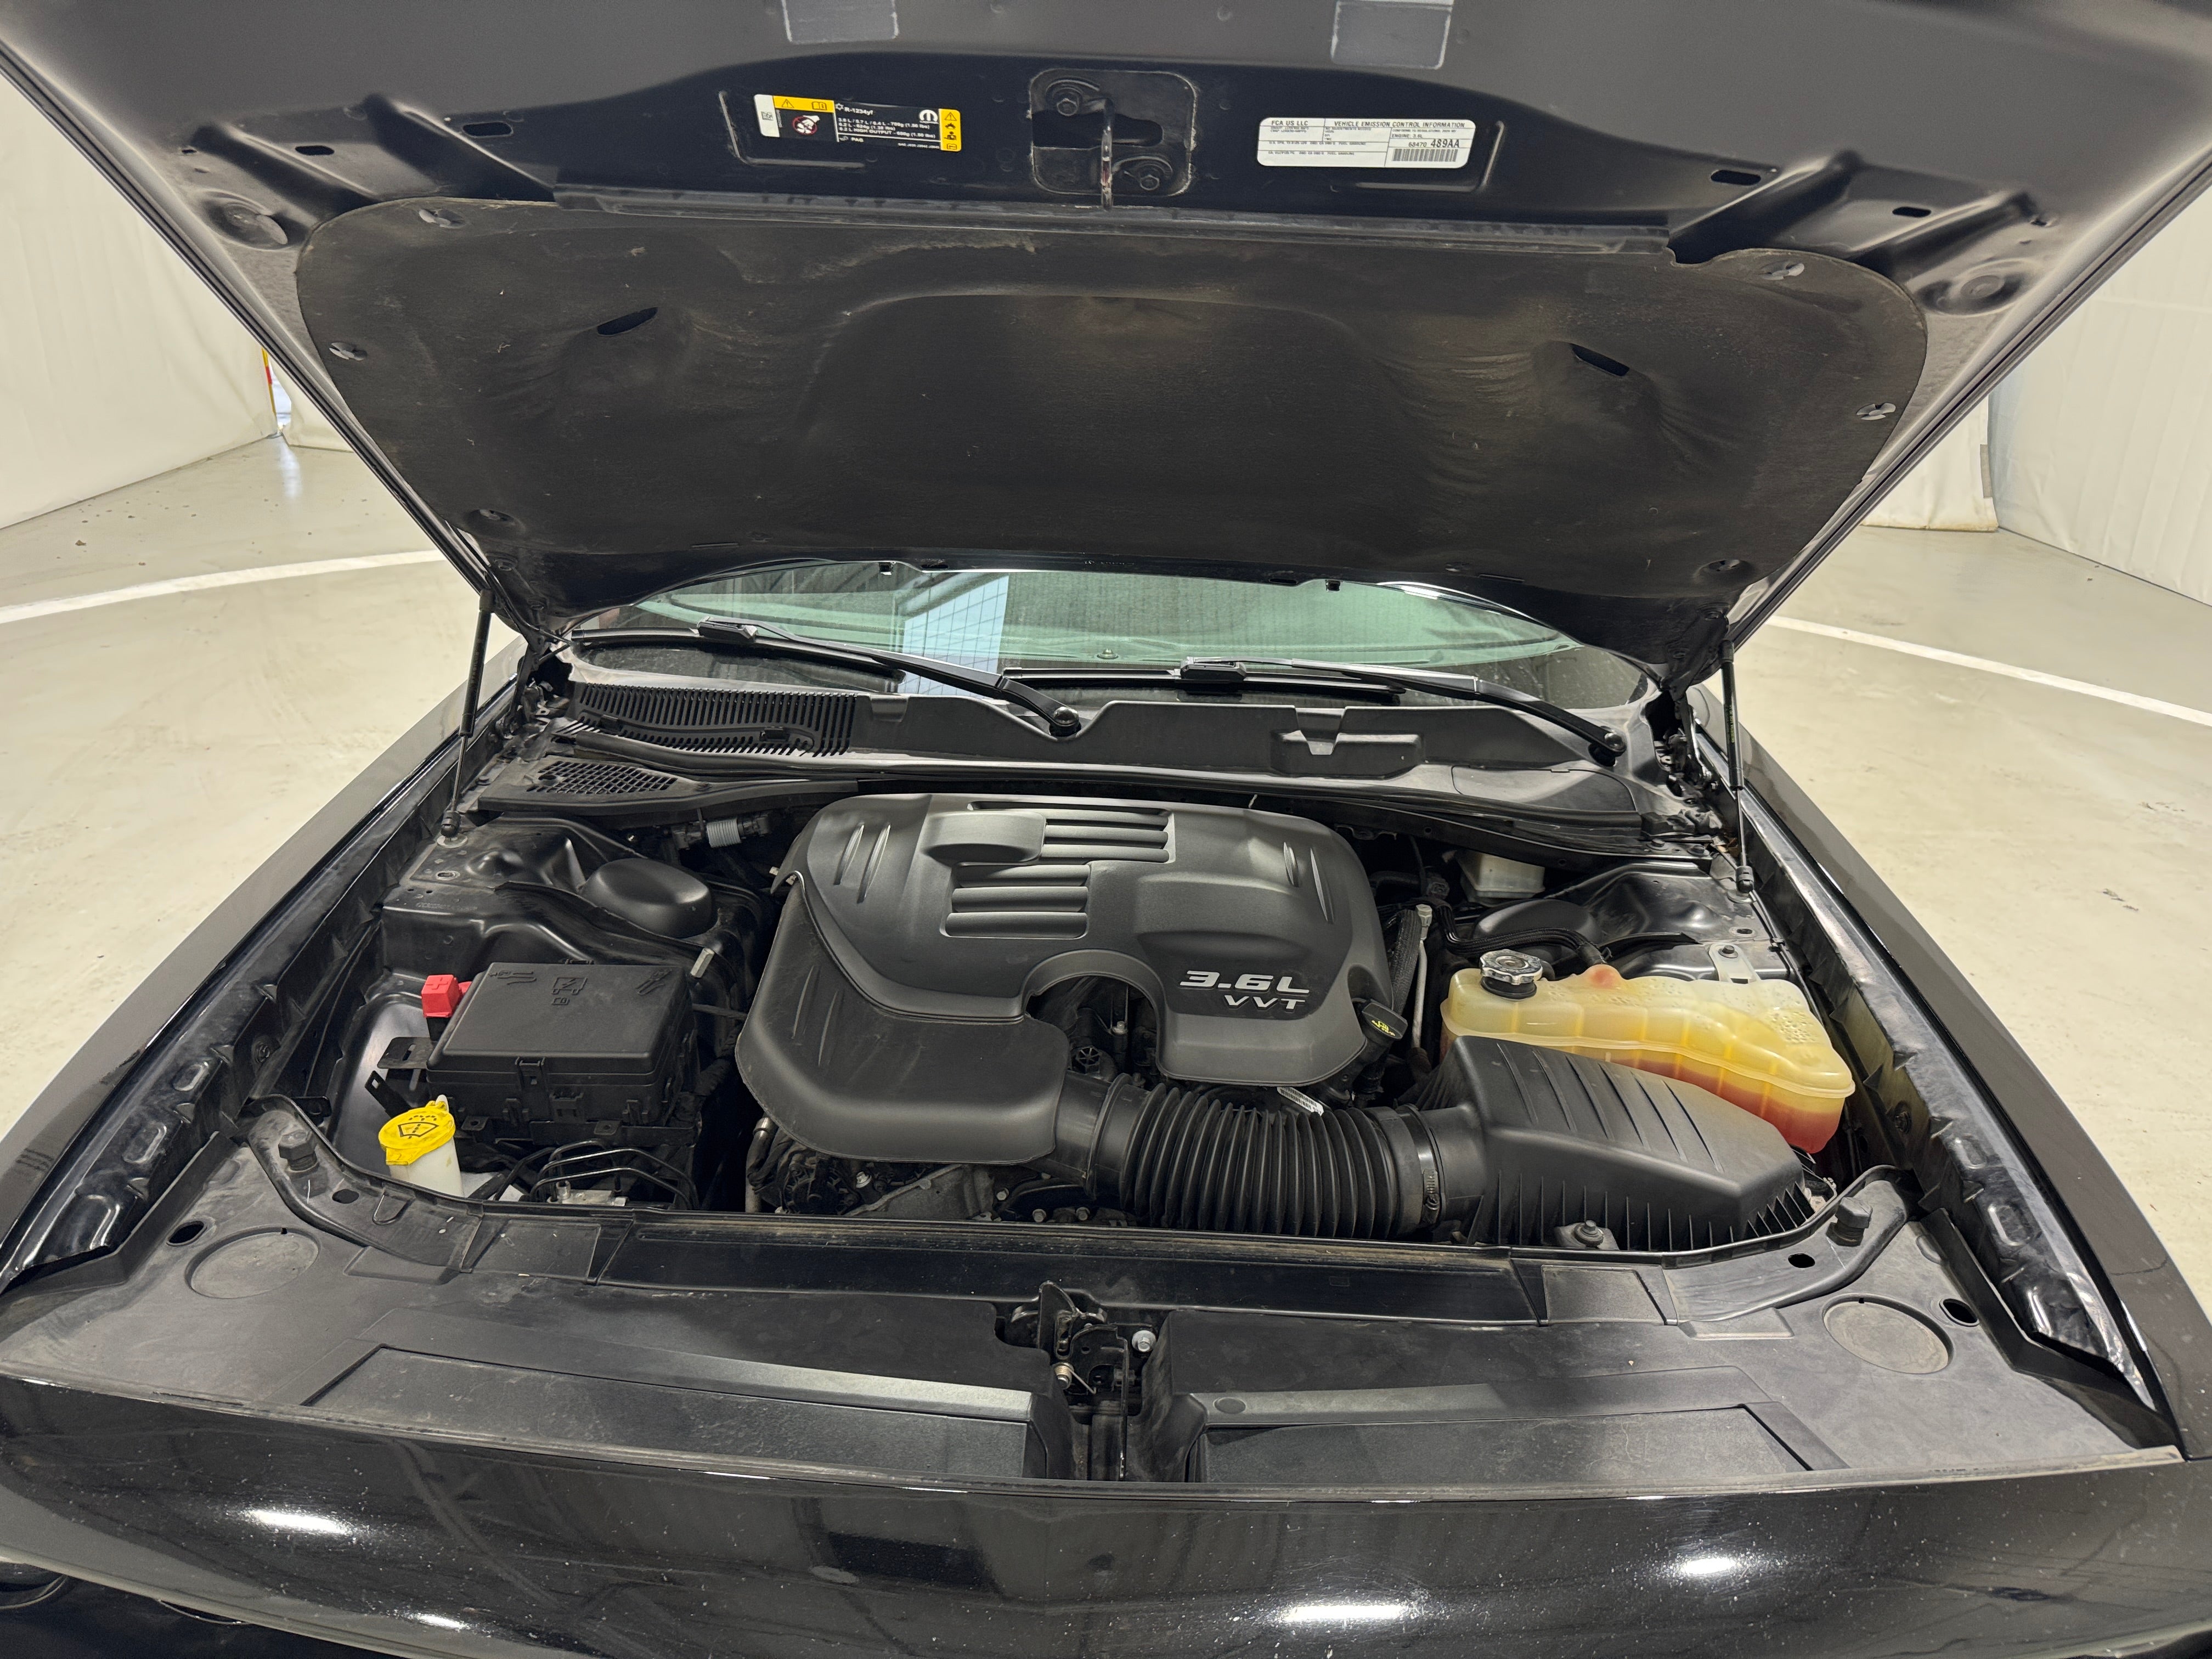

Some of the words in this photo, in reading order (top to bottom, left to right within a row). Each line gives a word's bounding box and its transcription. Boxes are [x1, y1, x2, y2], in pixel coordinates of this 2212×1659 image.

[844, 107, 873, 116] R-1234yf
[1430, 139, 1459, 148] 489AA
[1179, 969, 1310, 995] 3.6L
[1223, 994, 1306, 1011] VVT
